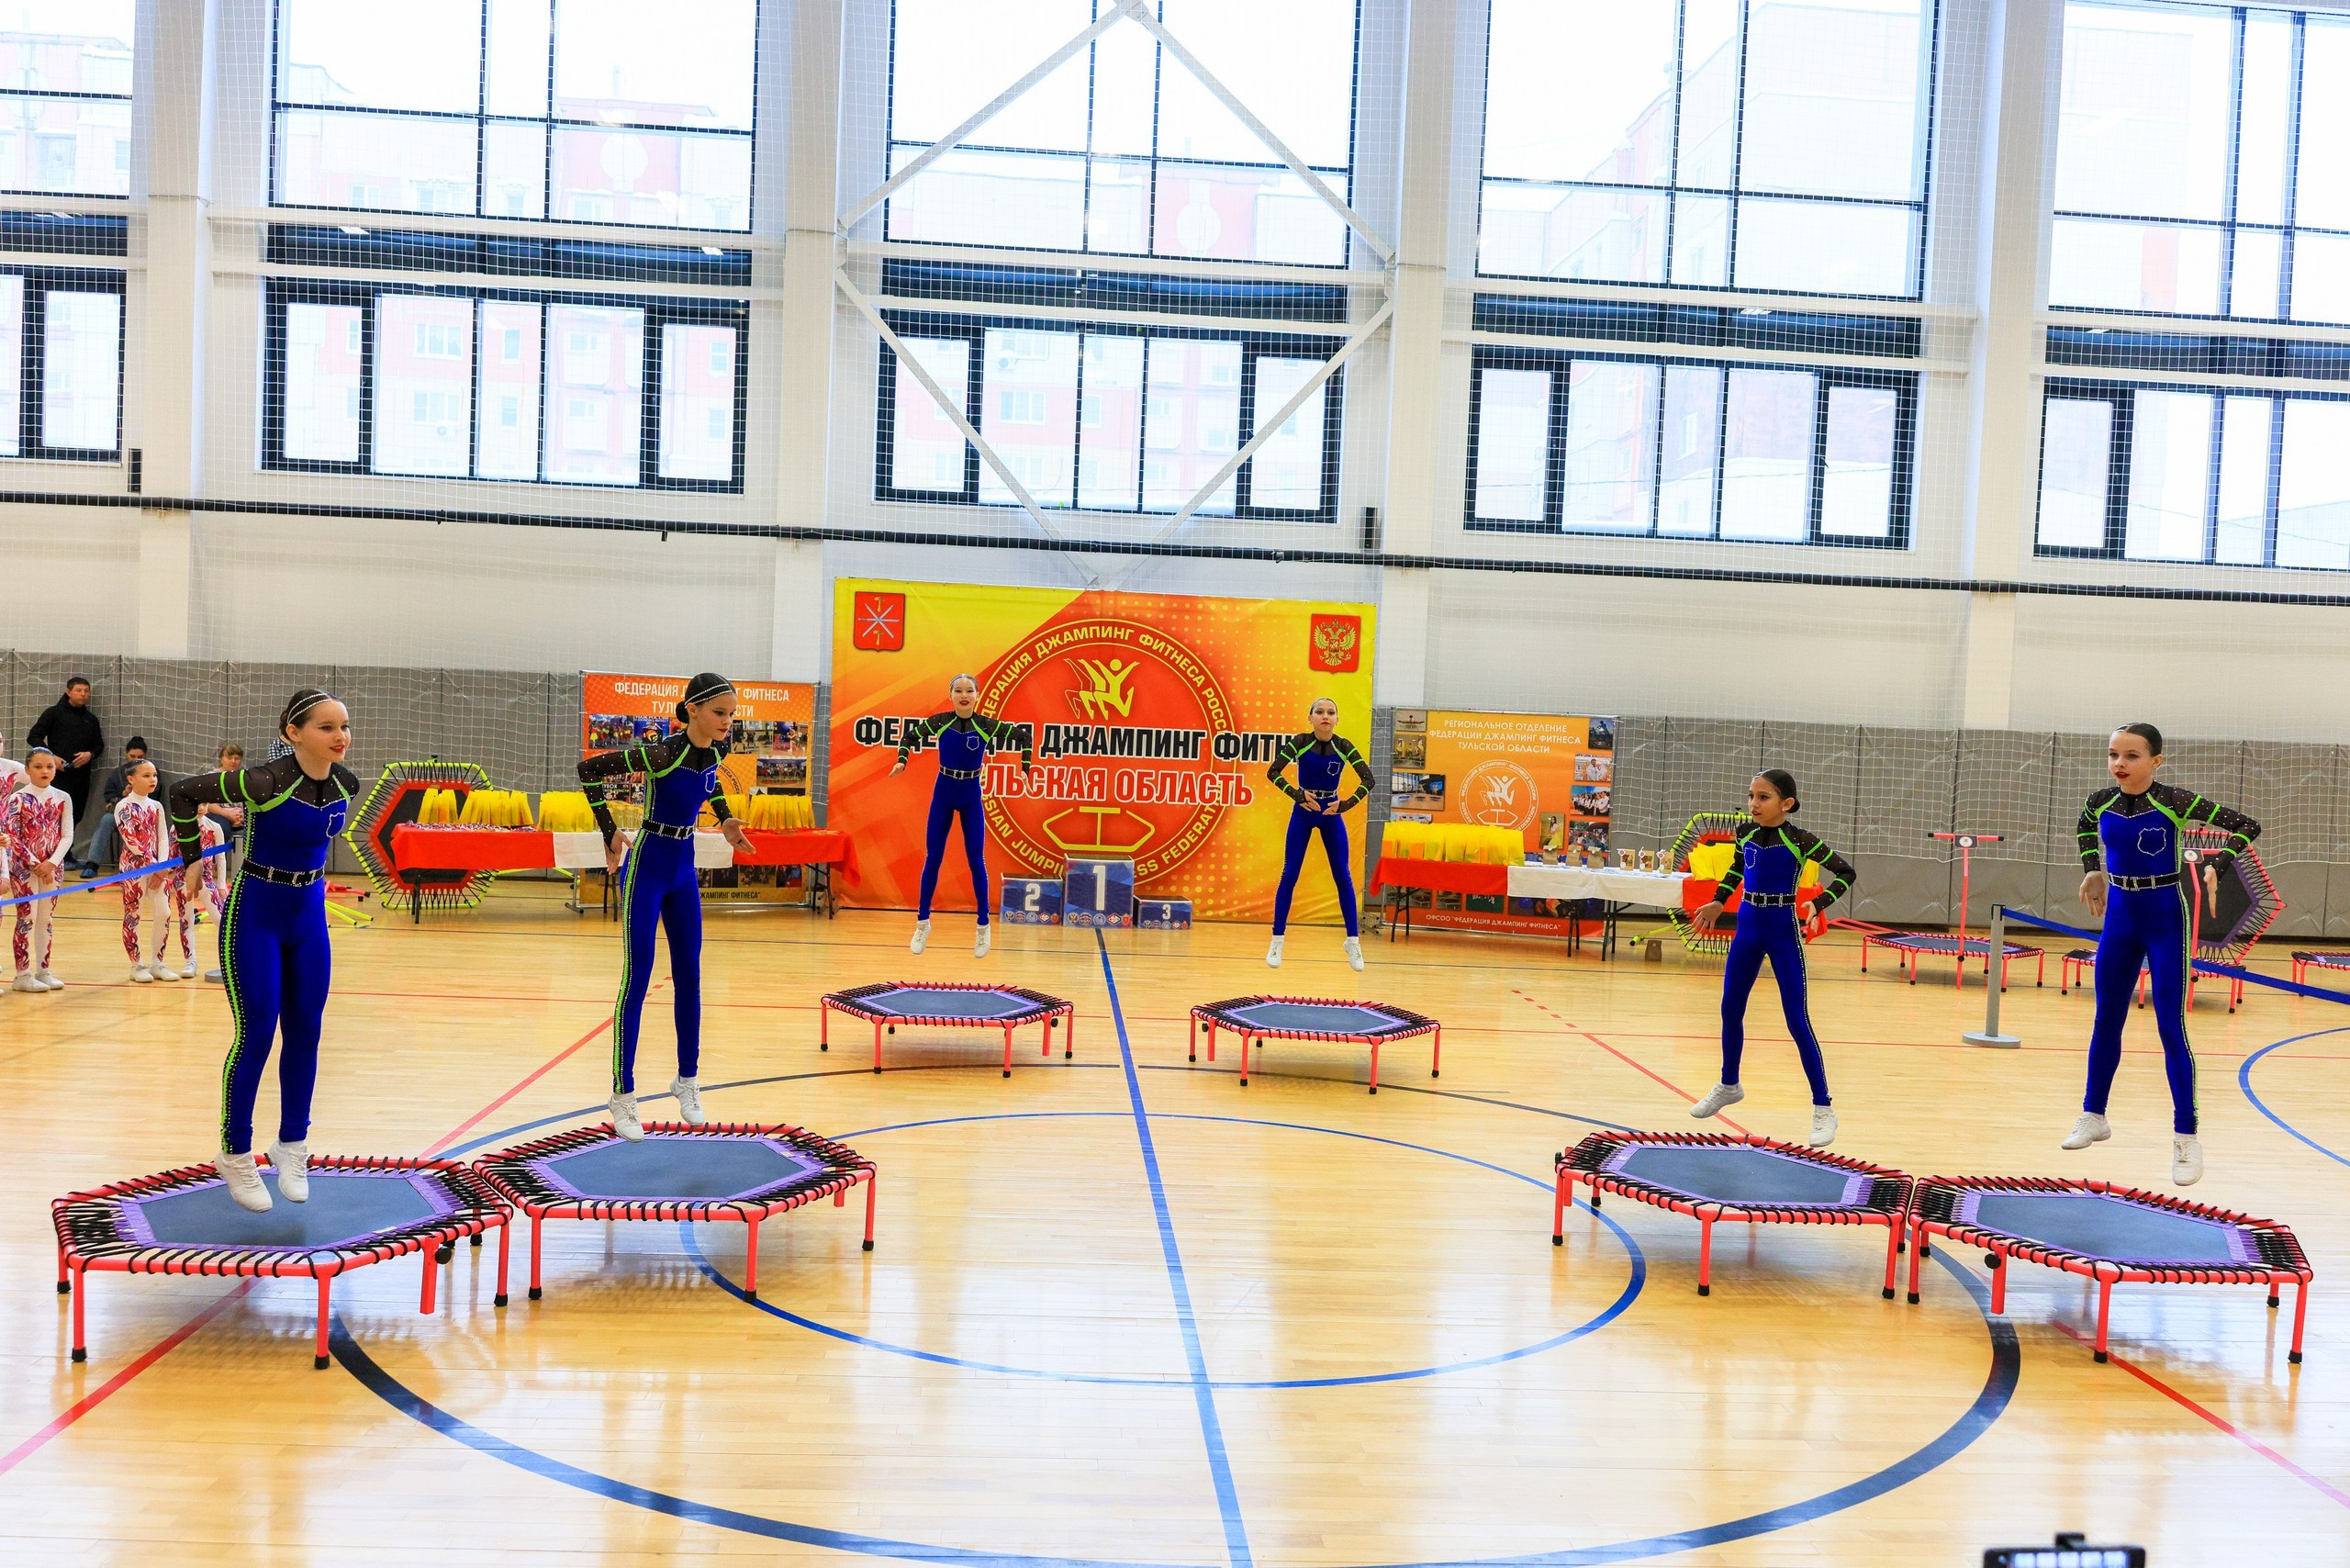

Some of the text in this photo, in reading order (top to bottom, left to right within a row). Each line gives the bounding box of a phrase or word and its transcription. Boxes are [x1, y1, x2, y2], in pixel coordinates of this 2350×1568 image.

[614, 682, 678, 697] ФЕДЕРАЦИЯ
[743, 688, 789, 701] ФИТНЕСА
[981, 626, 1227, 732] ДЕРАЦИЯ ДЖАМПИНГ ФИТНЕСА РОСС
[1429, 730, 1581, 745] ФЕДЕРАЦИИ ДЖАМПИНГ ФИТНЕСА
[1444, 719, 1567, 734] РЕГИОНАЛЬНОЕ ОТДЕЛЕНИЕ
[1040, 723, 1207, 761] ДЖАМПИНГ
[1213, 731, 1297, 764] ФИТН
[1458, 741, 1550, 754] ТУЛЬСКОЙ ОБЛАСТИ
[982, 764, 1253, 807] ЛЬСКАЯ ОБЛАСТЬ
[1161, 801, 1217, 864] FEDERAT
[1011, 840, 1064, 876] JUMPI
[1024, 883, 1041, 912] 2
[1092, 865, 1106, 911] 1
[1162, 904, 1171, 920] 3
[1492, 919, 1528, 928] ДЖАМПИНГ
